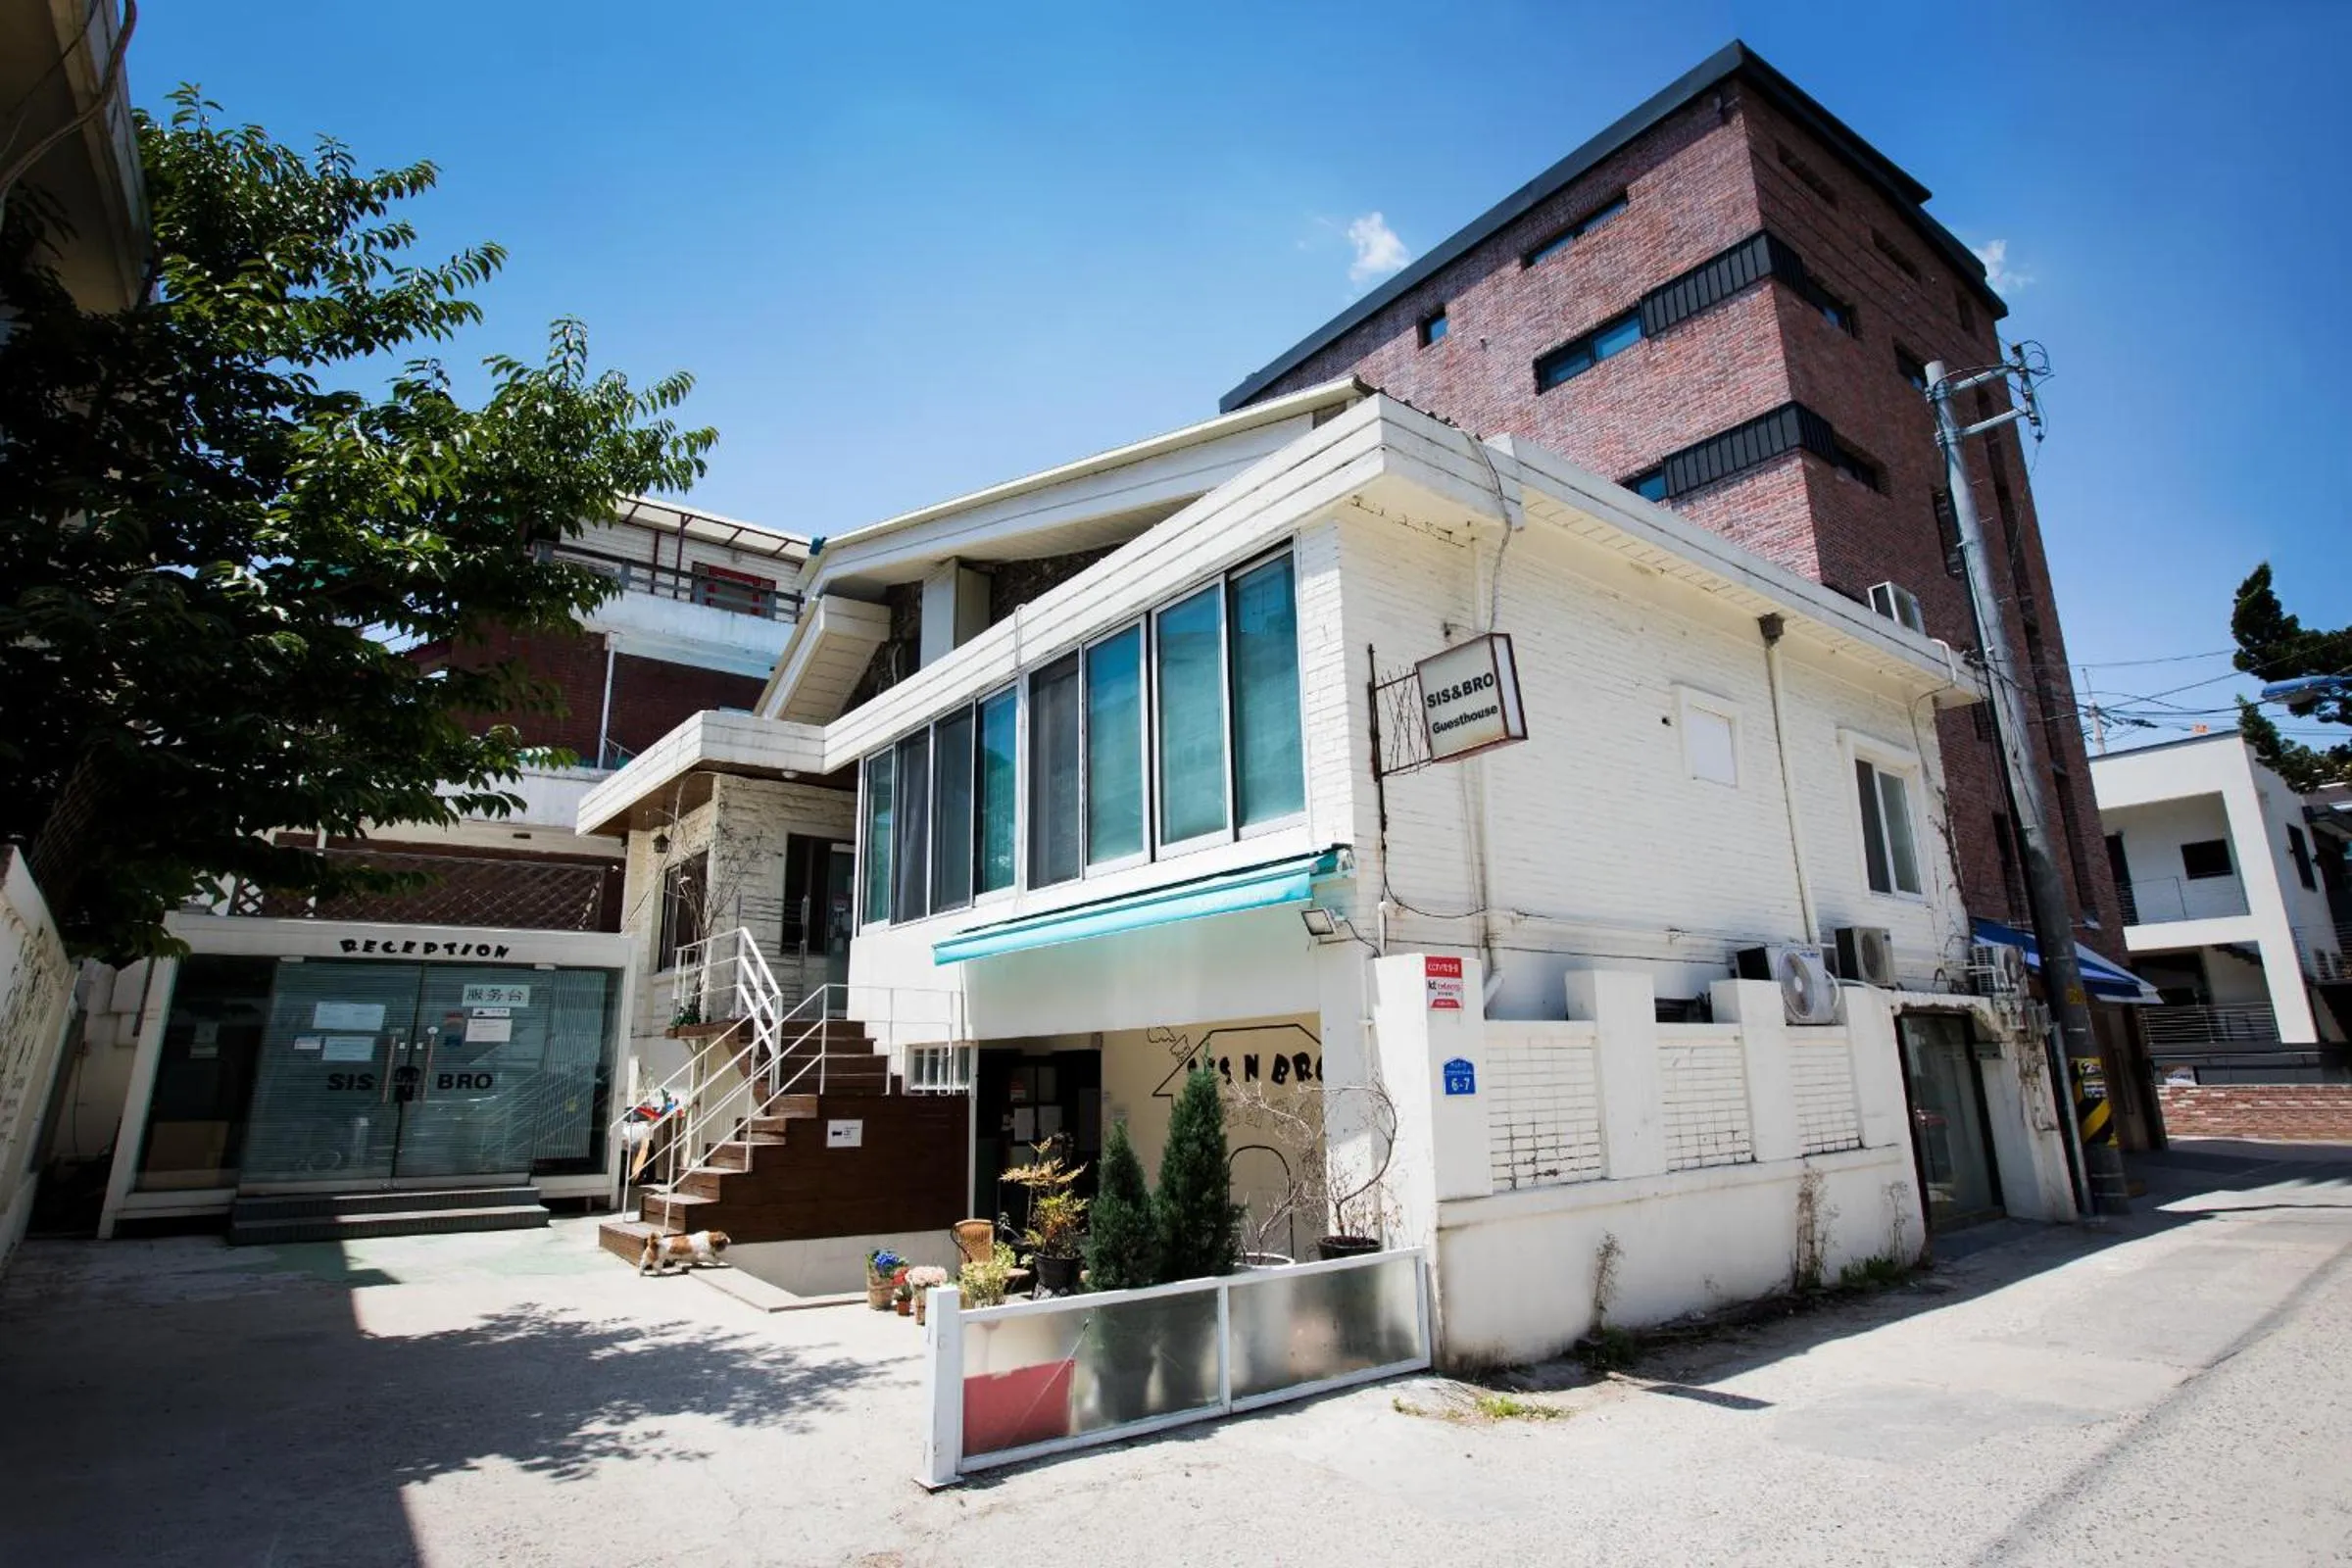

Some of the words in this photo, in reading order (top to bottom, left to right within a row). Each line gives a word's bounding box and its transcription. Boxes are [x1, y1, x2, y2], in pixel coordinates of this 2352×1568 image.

[1426, 672, 1494, 709] SIS&BRO
[1432, 704, 1498, 734] Guesthouse
[340, 938, 510, 959] RECEPTION
[466, 987, 524, 1002] 服务台
[1244, 1054, 1259, 1083] N
[327, 1072, 375, 1091] SIS
[437, 1073, 494, 1091] BRO
